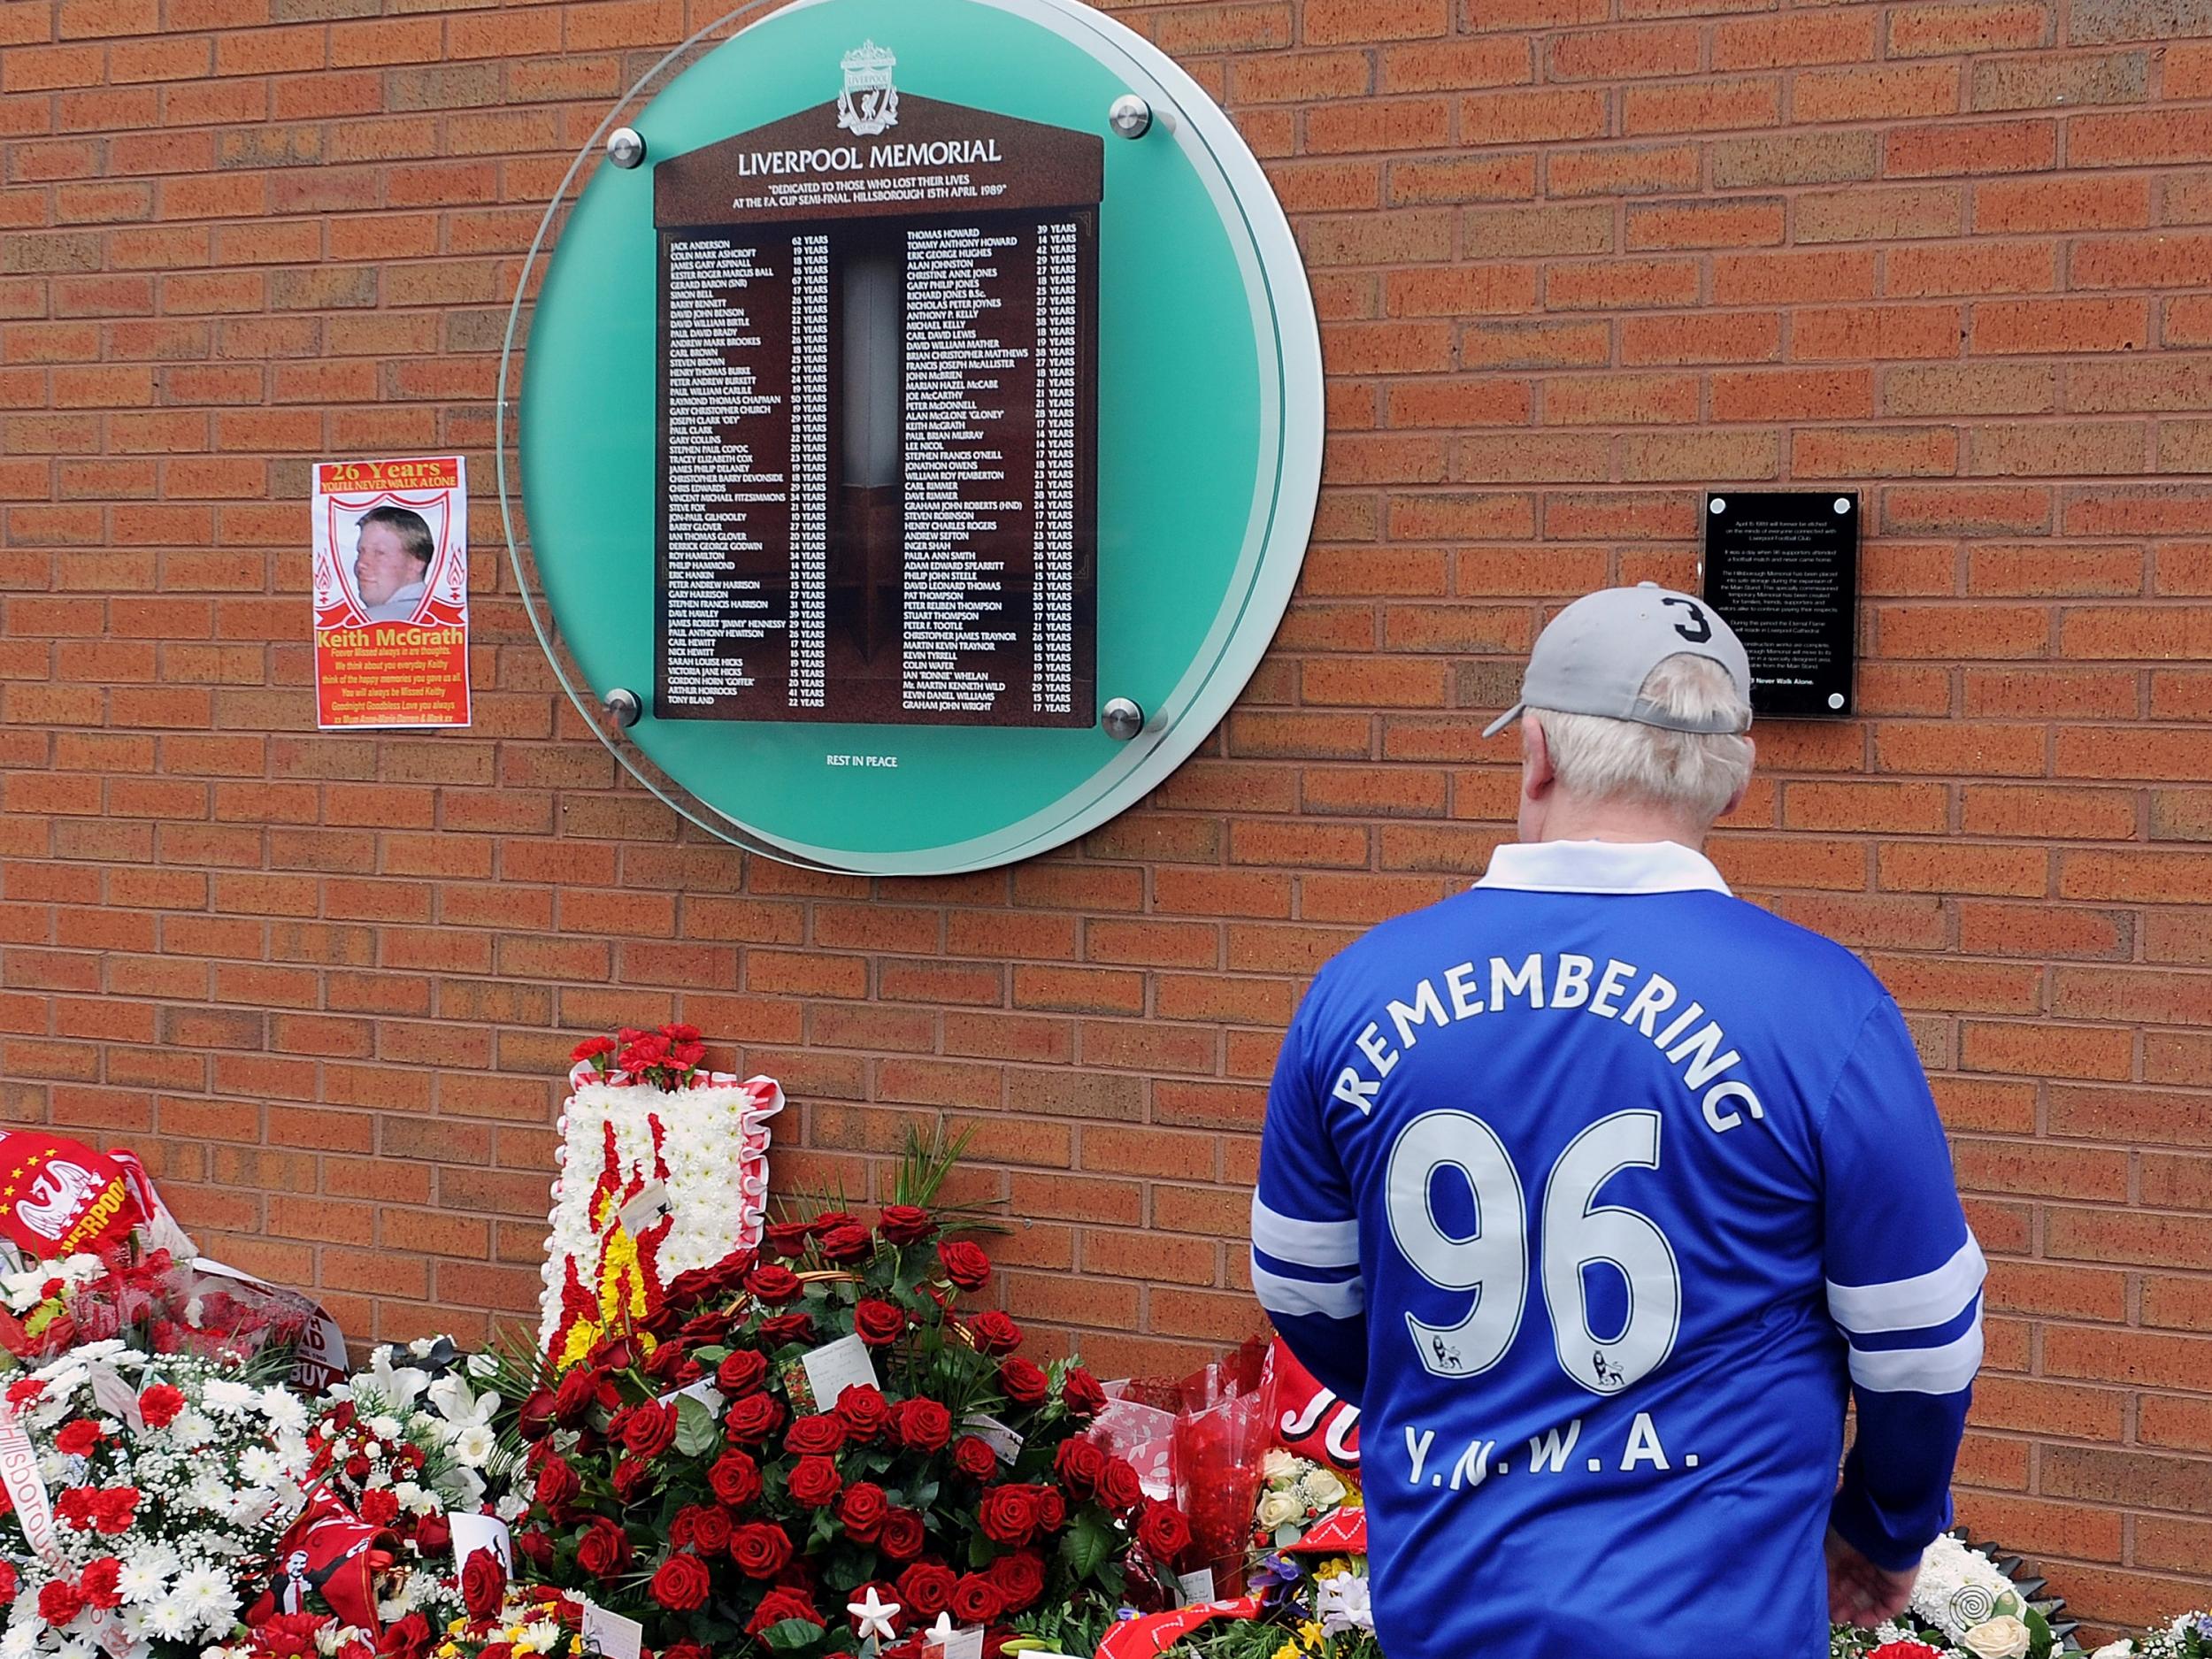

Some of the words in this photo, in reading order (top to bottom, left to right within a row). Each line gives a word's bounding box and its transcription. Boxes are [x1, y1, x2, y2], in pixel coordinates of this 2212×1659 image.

[739, 148, 864, 175] LIVERPOOL
[870, 140, 1002, 168] MEMORIAL
[821, 182, 834, 193] TO
[835, 180, 865, 191] THOSE
[867, 179, 891, 189] WHO
[893, 177, 917, 188] LOST
[918, 175, 944, 188] THEIR
[945, 173, 970, 186] LIVES
[733, 198, 744, 209] AT
[745, 198, 763, 208] THE
[764, 196, 779, 207] F.A.
[779, 196, 798, 206] CUP
[853, 188, 924, 203] HILLSBOROUGH
[927, 188, 949, 198] 15TH
[950, 186, 978, 197] APRIL
[804, 236, 827, 245] YEARS
[1050, 234, 1076, 243] YEARS
[1050, 255, 1075, 265] YEARS
[803, 394, 826, 403] YEARS
[1048, 388, 1074, 397] YEARS
[332, 464, 359, 481] 26
[368, 462, 441, 479] Years
[322, 481, 354, 492] YOU'LL
[356, 480, 388, 490] NEVER
[388, 478, 418, 488] WALK
[1047, 551, 1071, 560] YEARS
[1046, 612, 1071, 621] YEARS
[1662, 598, 1712, 643] 3
[318, 629, 370, 648] Keith
[376, 627, 464, 646] McGrath
[800, 698, 824, 707] YEARS
[826, 756, 850, 766] REST
[853, 756, 864, 766] IN
[866, 756, 898, 768] PEACE
[1333, 953, 1763, 1133] REMEMBERING
[1386, 1109, 1681, 1395] 96
[289, 1363, 329, 1390] BUY
[1406, 1413, 1698, 1491] Y.N.W.A.
